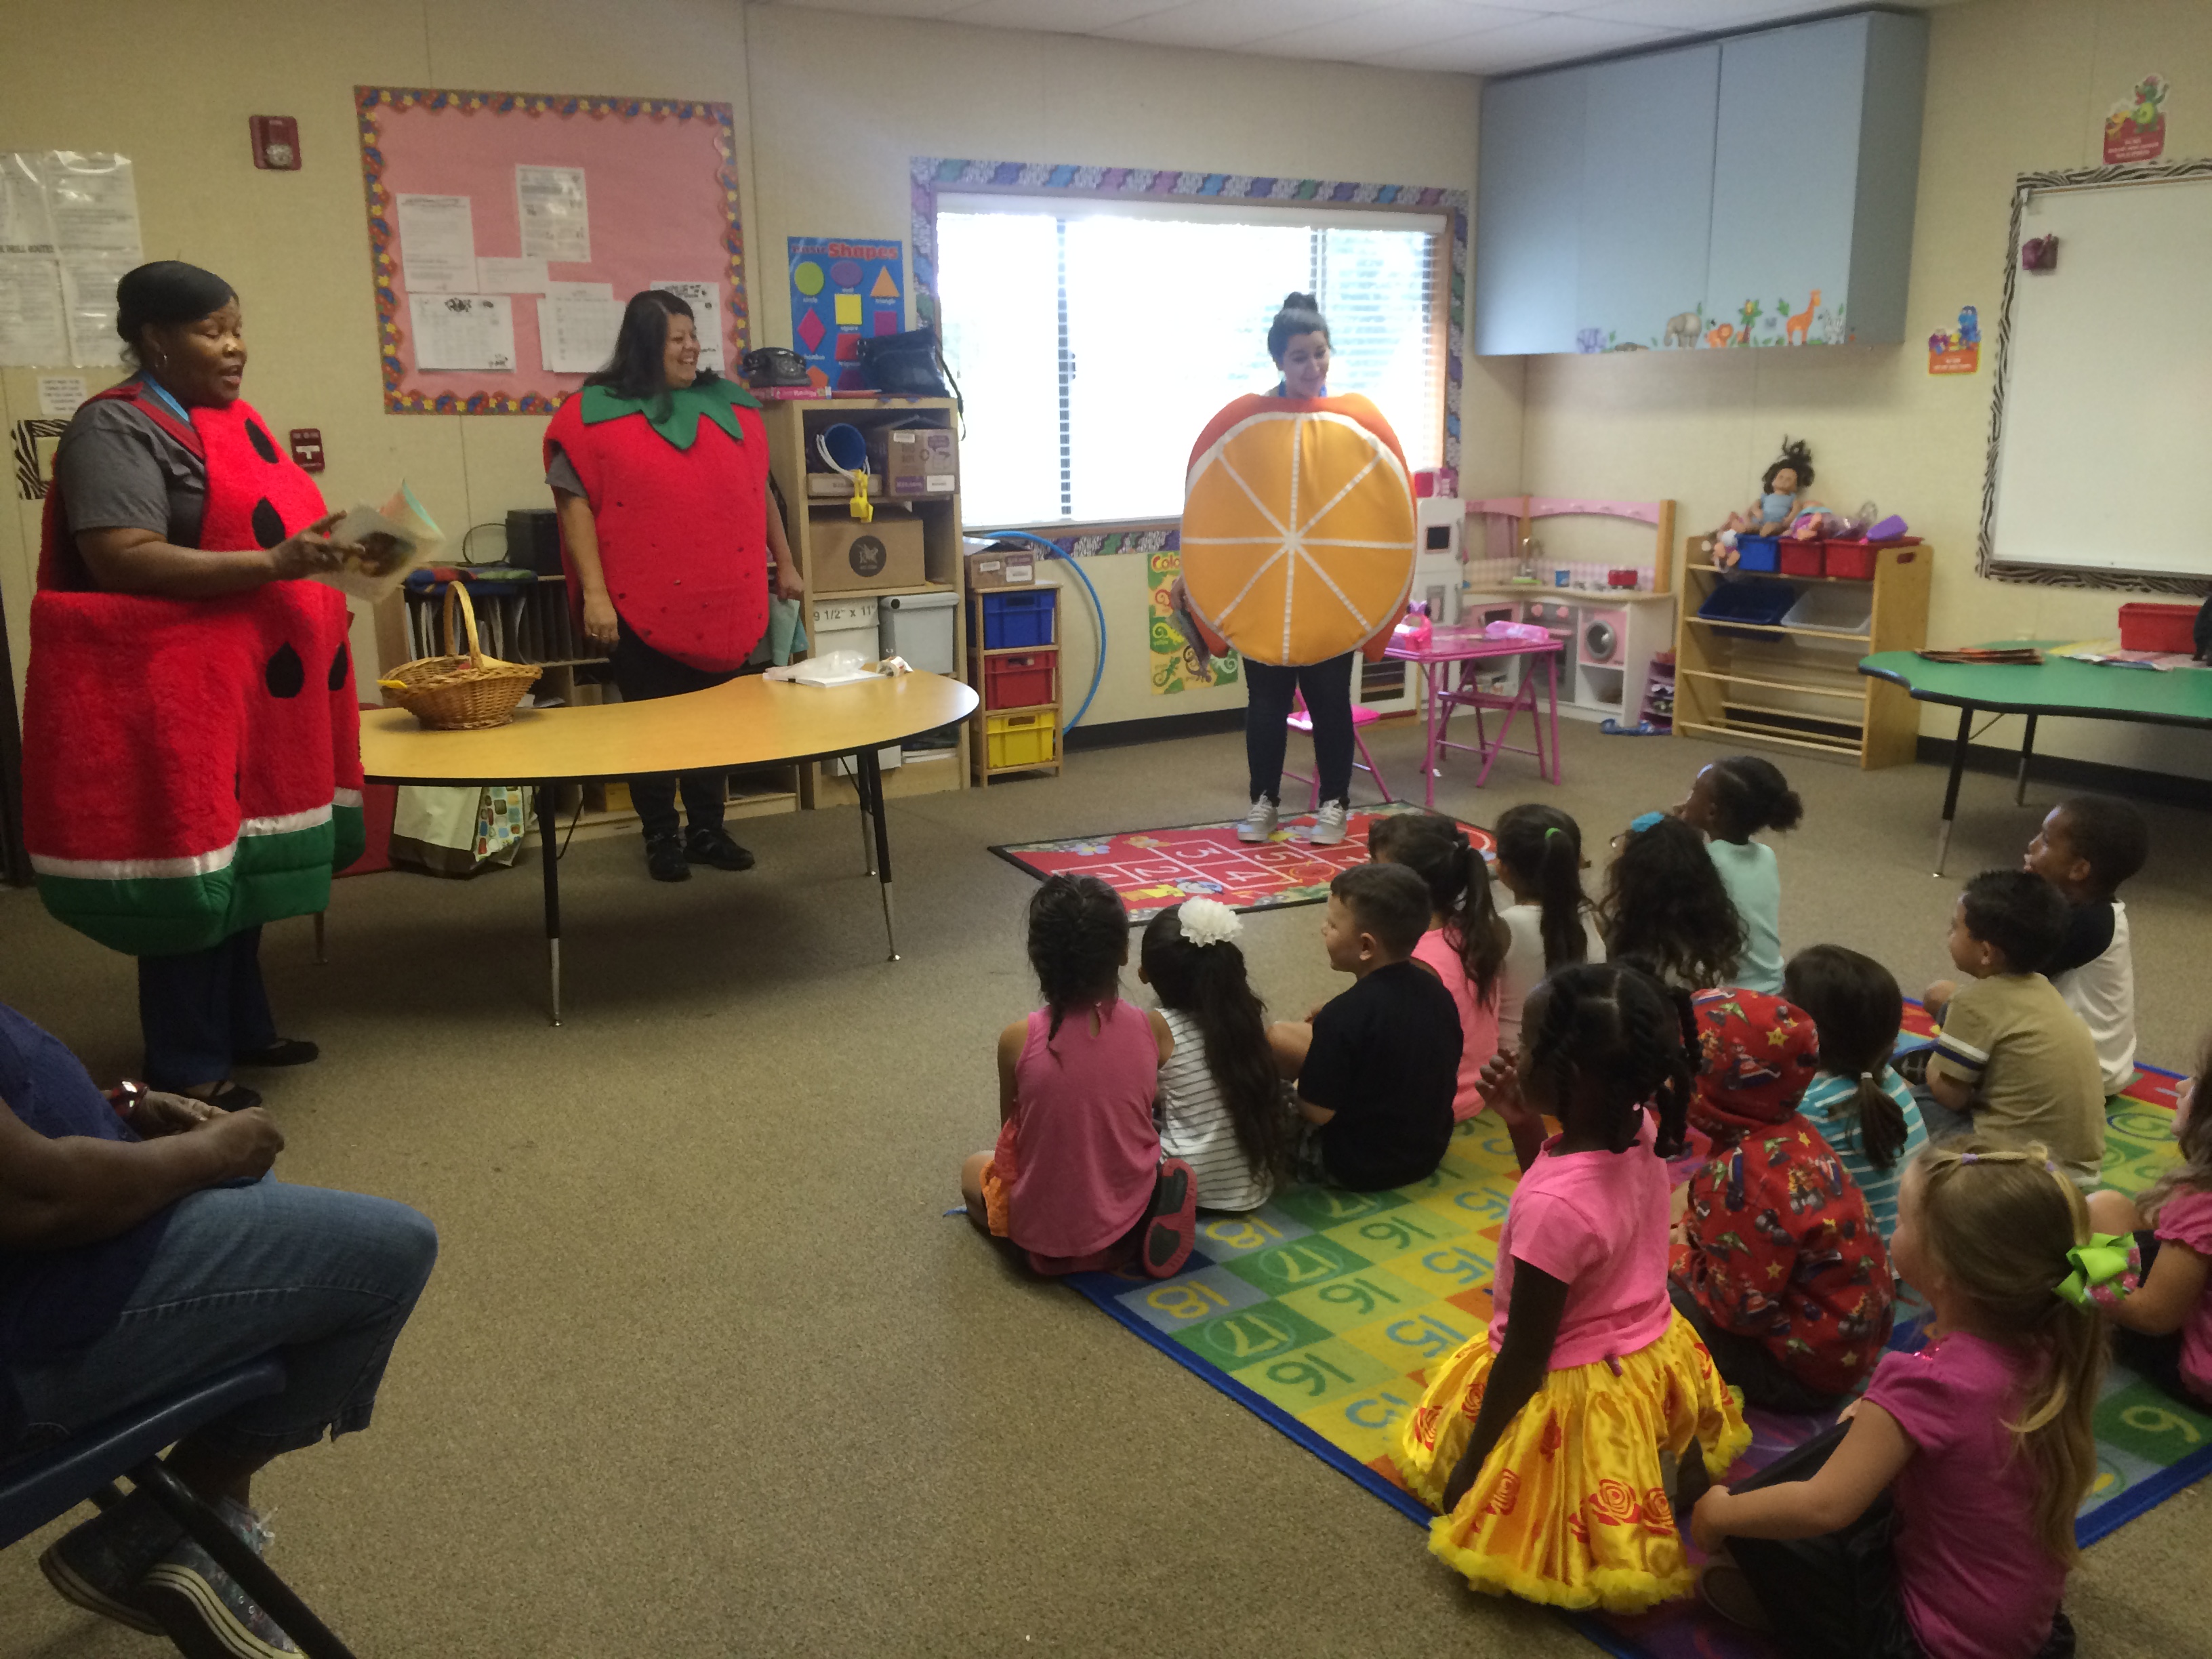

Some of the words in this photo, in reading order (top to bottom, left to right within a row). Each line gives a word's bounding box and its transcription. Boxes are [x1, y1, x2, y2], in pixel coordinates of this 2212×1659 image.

[828, 243, 898, 261] Shapes
[813, 610, 820, 621] 9
[1134, 865, 1181, 877] 2
[1225, 871, 1271, 882] 4
[1359, 1216, 1436, 1249] 16
[1147, 1280, 1230, 1319] 18
[1318, 1277, 1401, 1315] 16
[1267, 1352, 1355, 1397] 16
